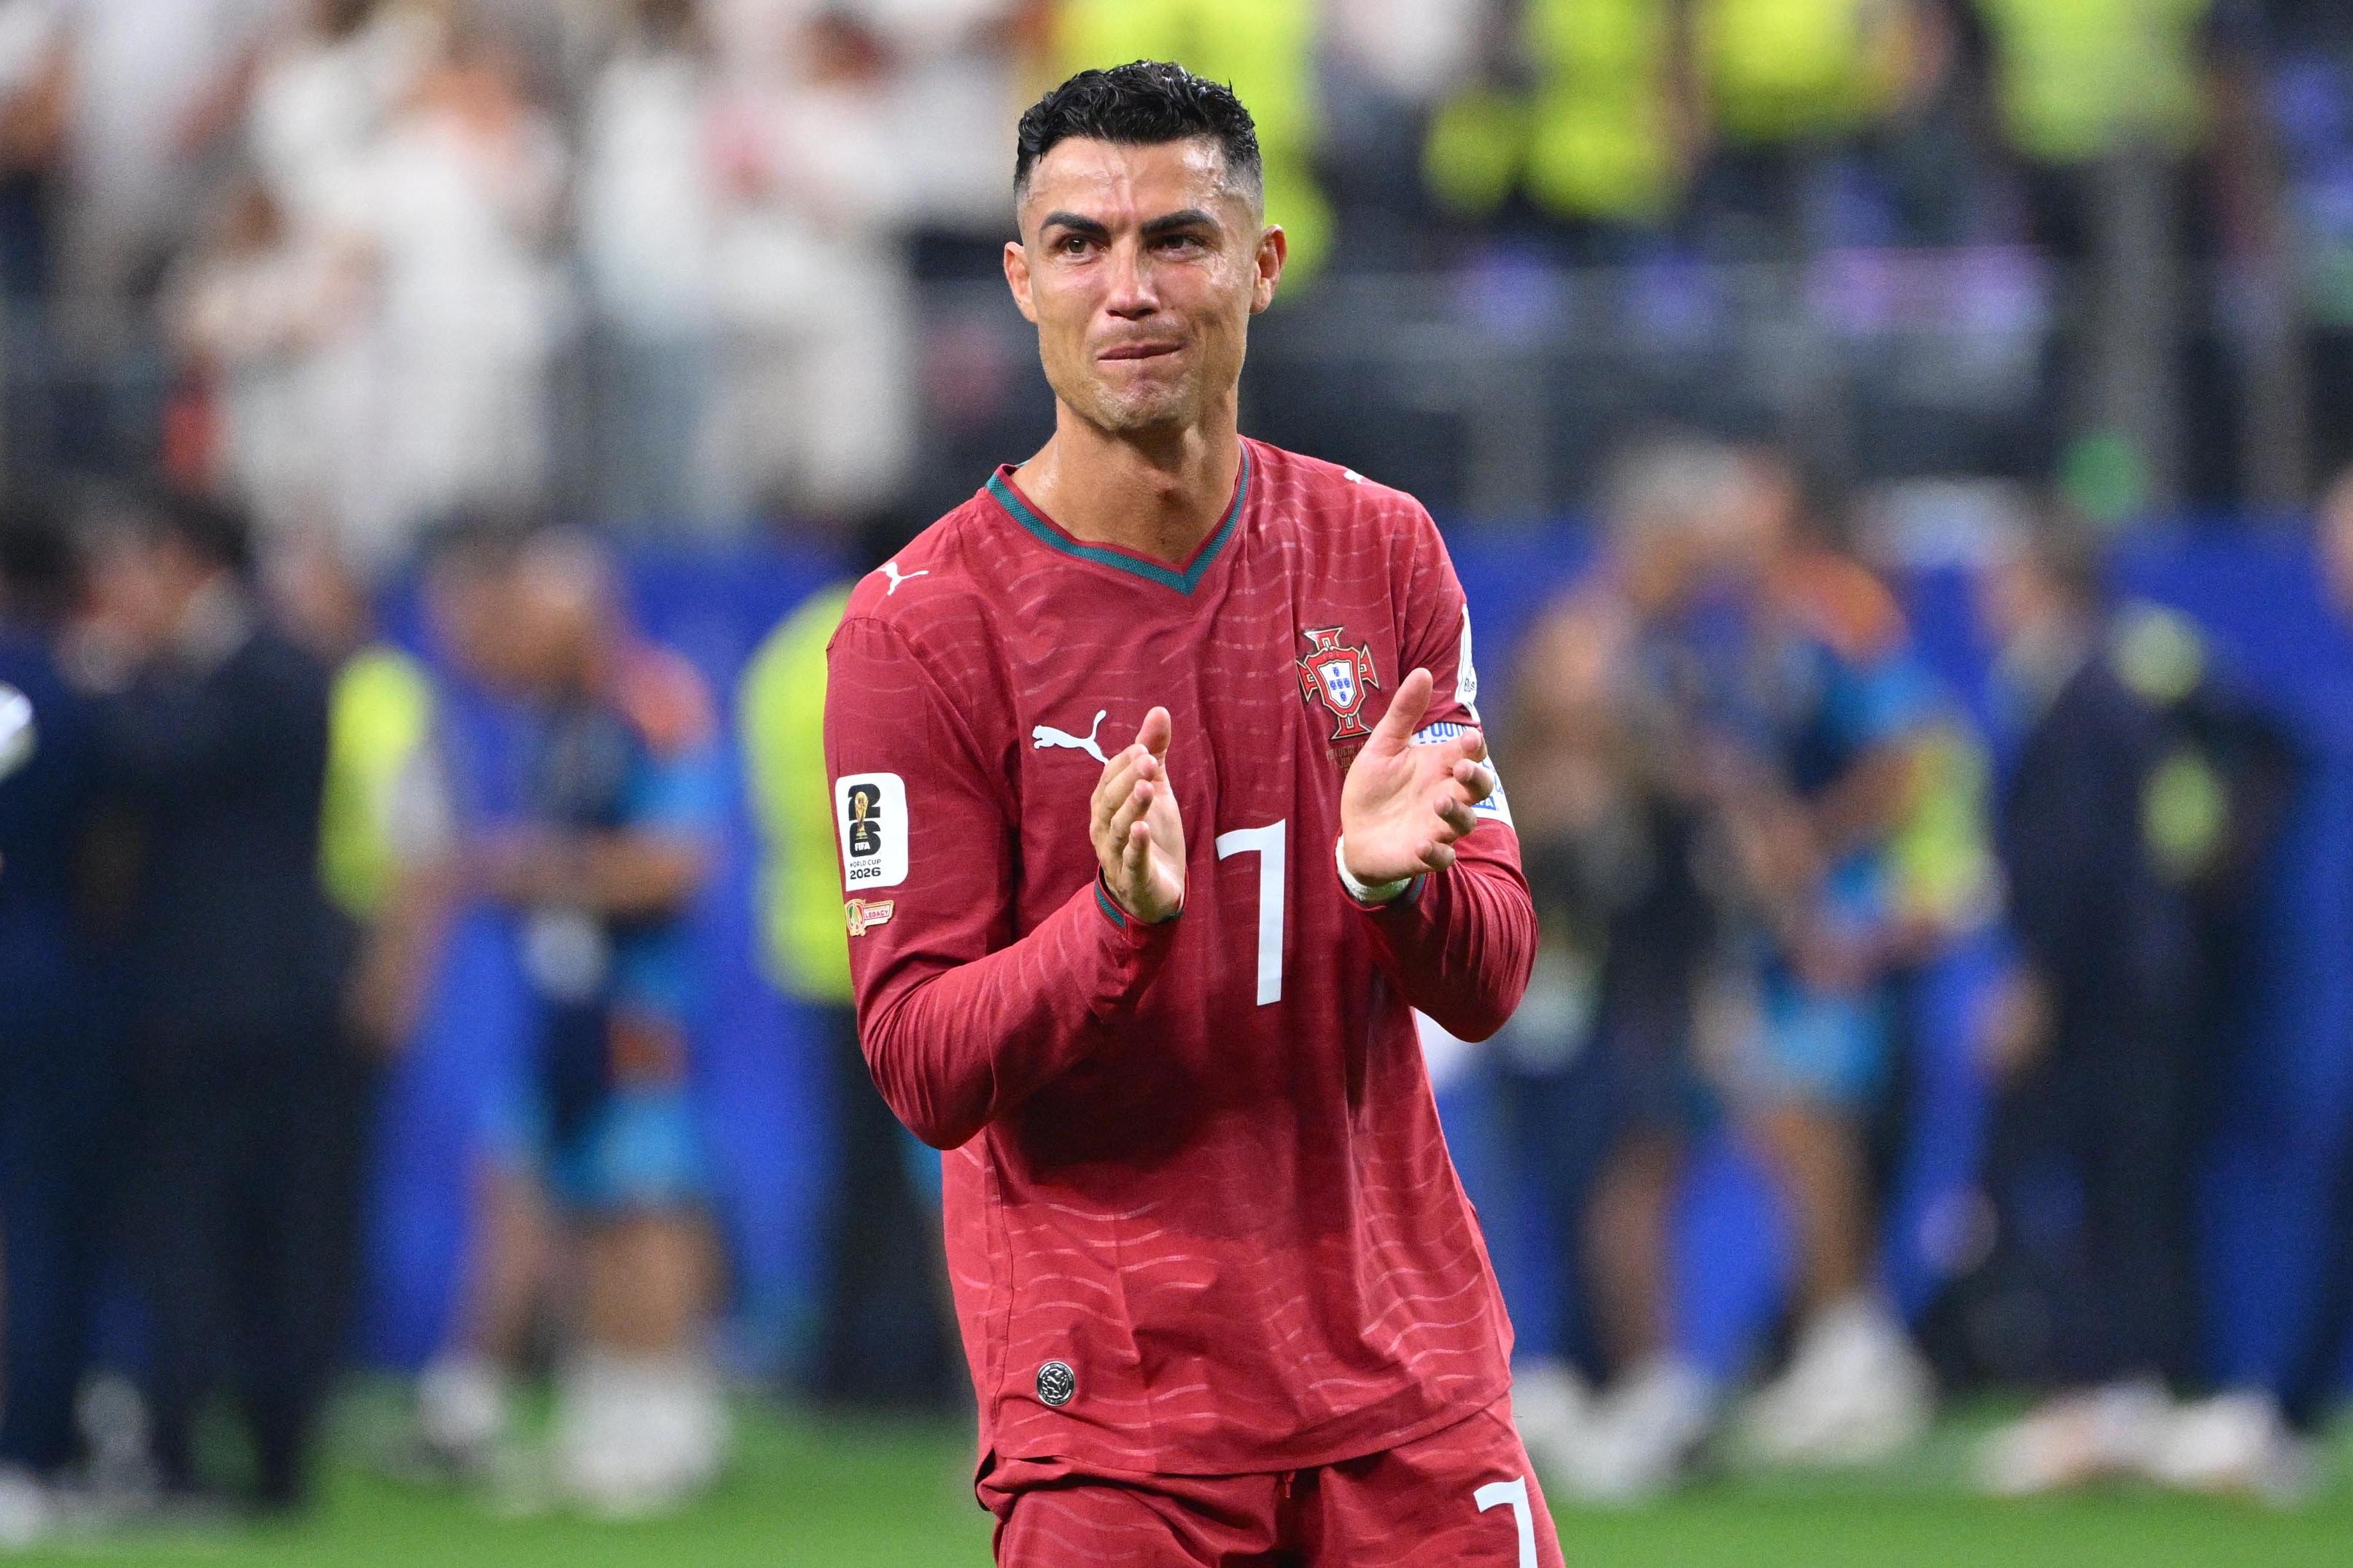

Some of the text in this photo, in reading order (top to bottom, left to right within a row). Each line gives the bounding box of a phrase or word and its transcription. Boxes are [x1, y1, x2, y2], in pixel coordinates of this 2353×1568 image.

[854, 841, 871, 851] FIFA
[850, 867, 881, 880] 2026
[865, 909, 888, 918] LEGACY
[1215, 818, 1286, 1006] 7
[1473, 1475, 1538, 1568] 7
